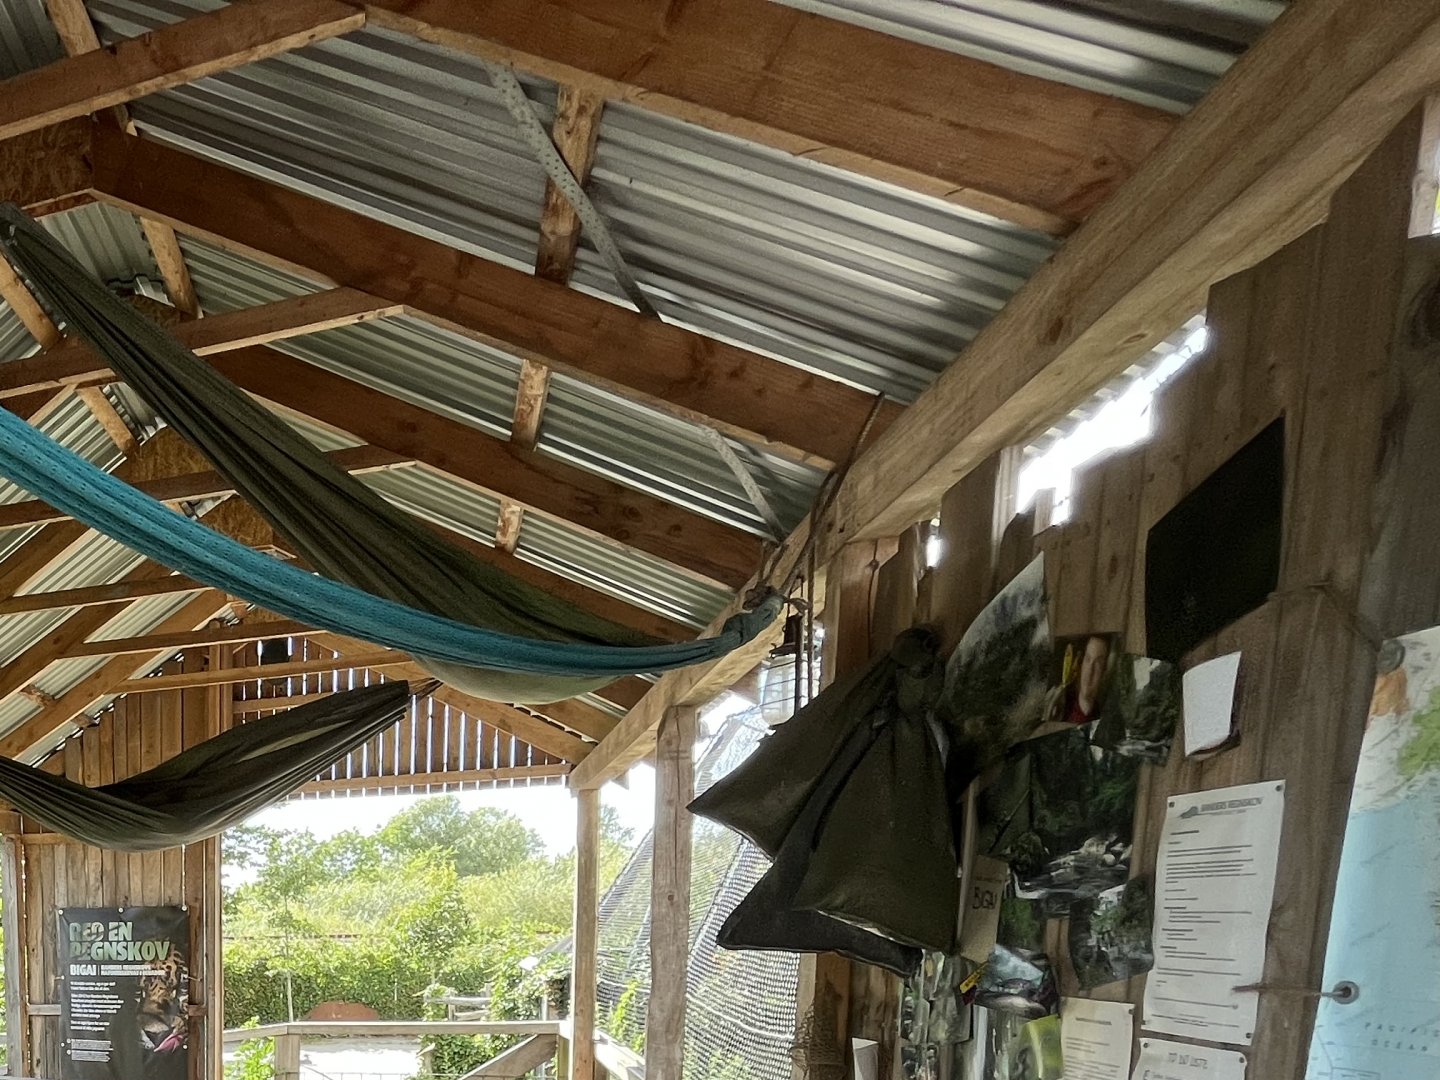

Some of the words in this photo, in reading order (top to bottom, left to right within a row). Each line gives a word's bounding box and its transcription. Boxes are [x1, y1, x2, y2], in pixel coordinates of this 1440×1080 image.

[69, 921, 104, 941] RED
[108, 921, 133, 941] EN
[69, 941, 170, 961] REGNSKOV
[69, 964, 97, 976] BIGAI
